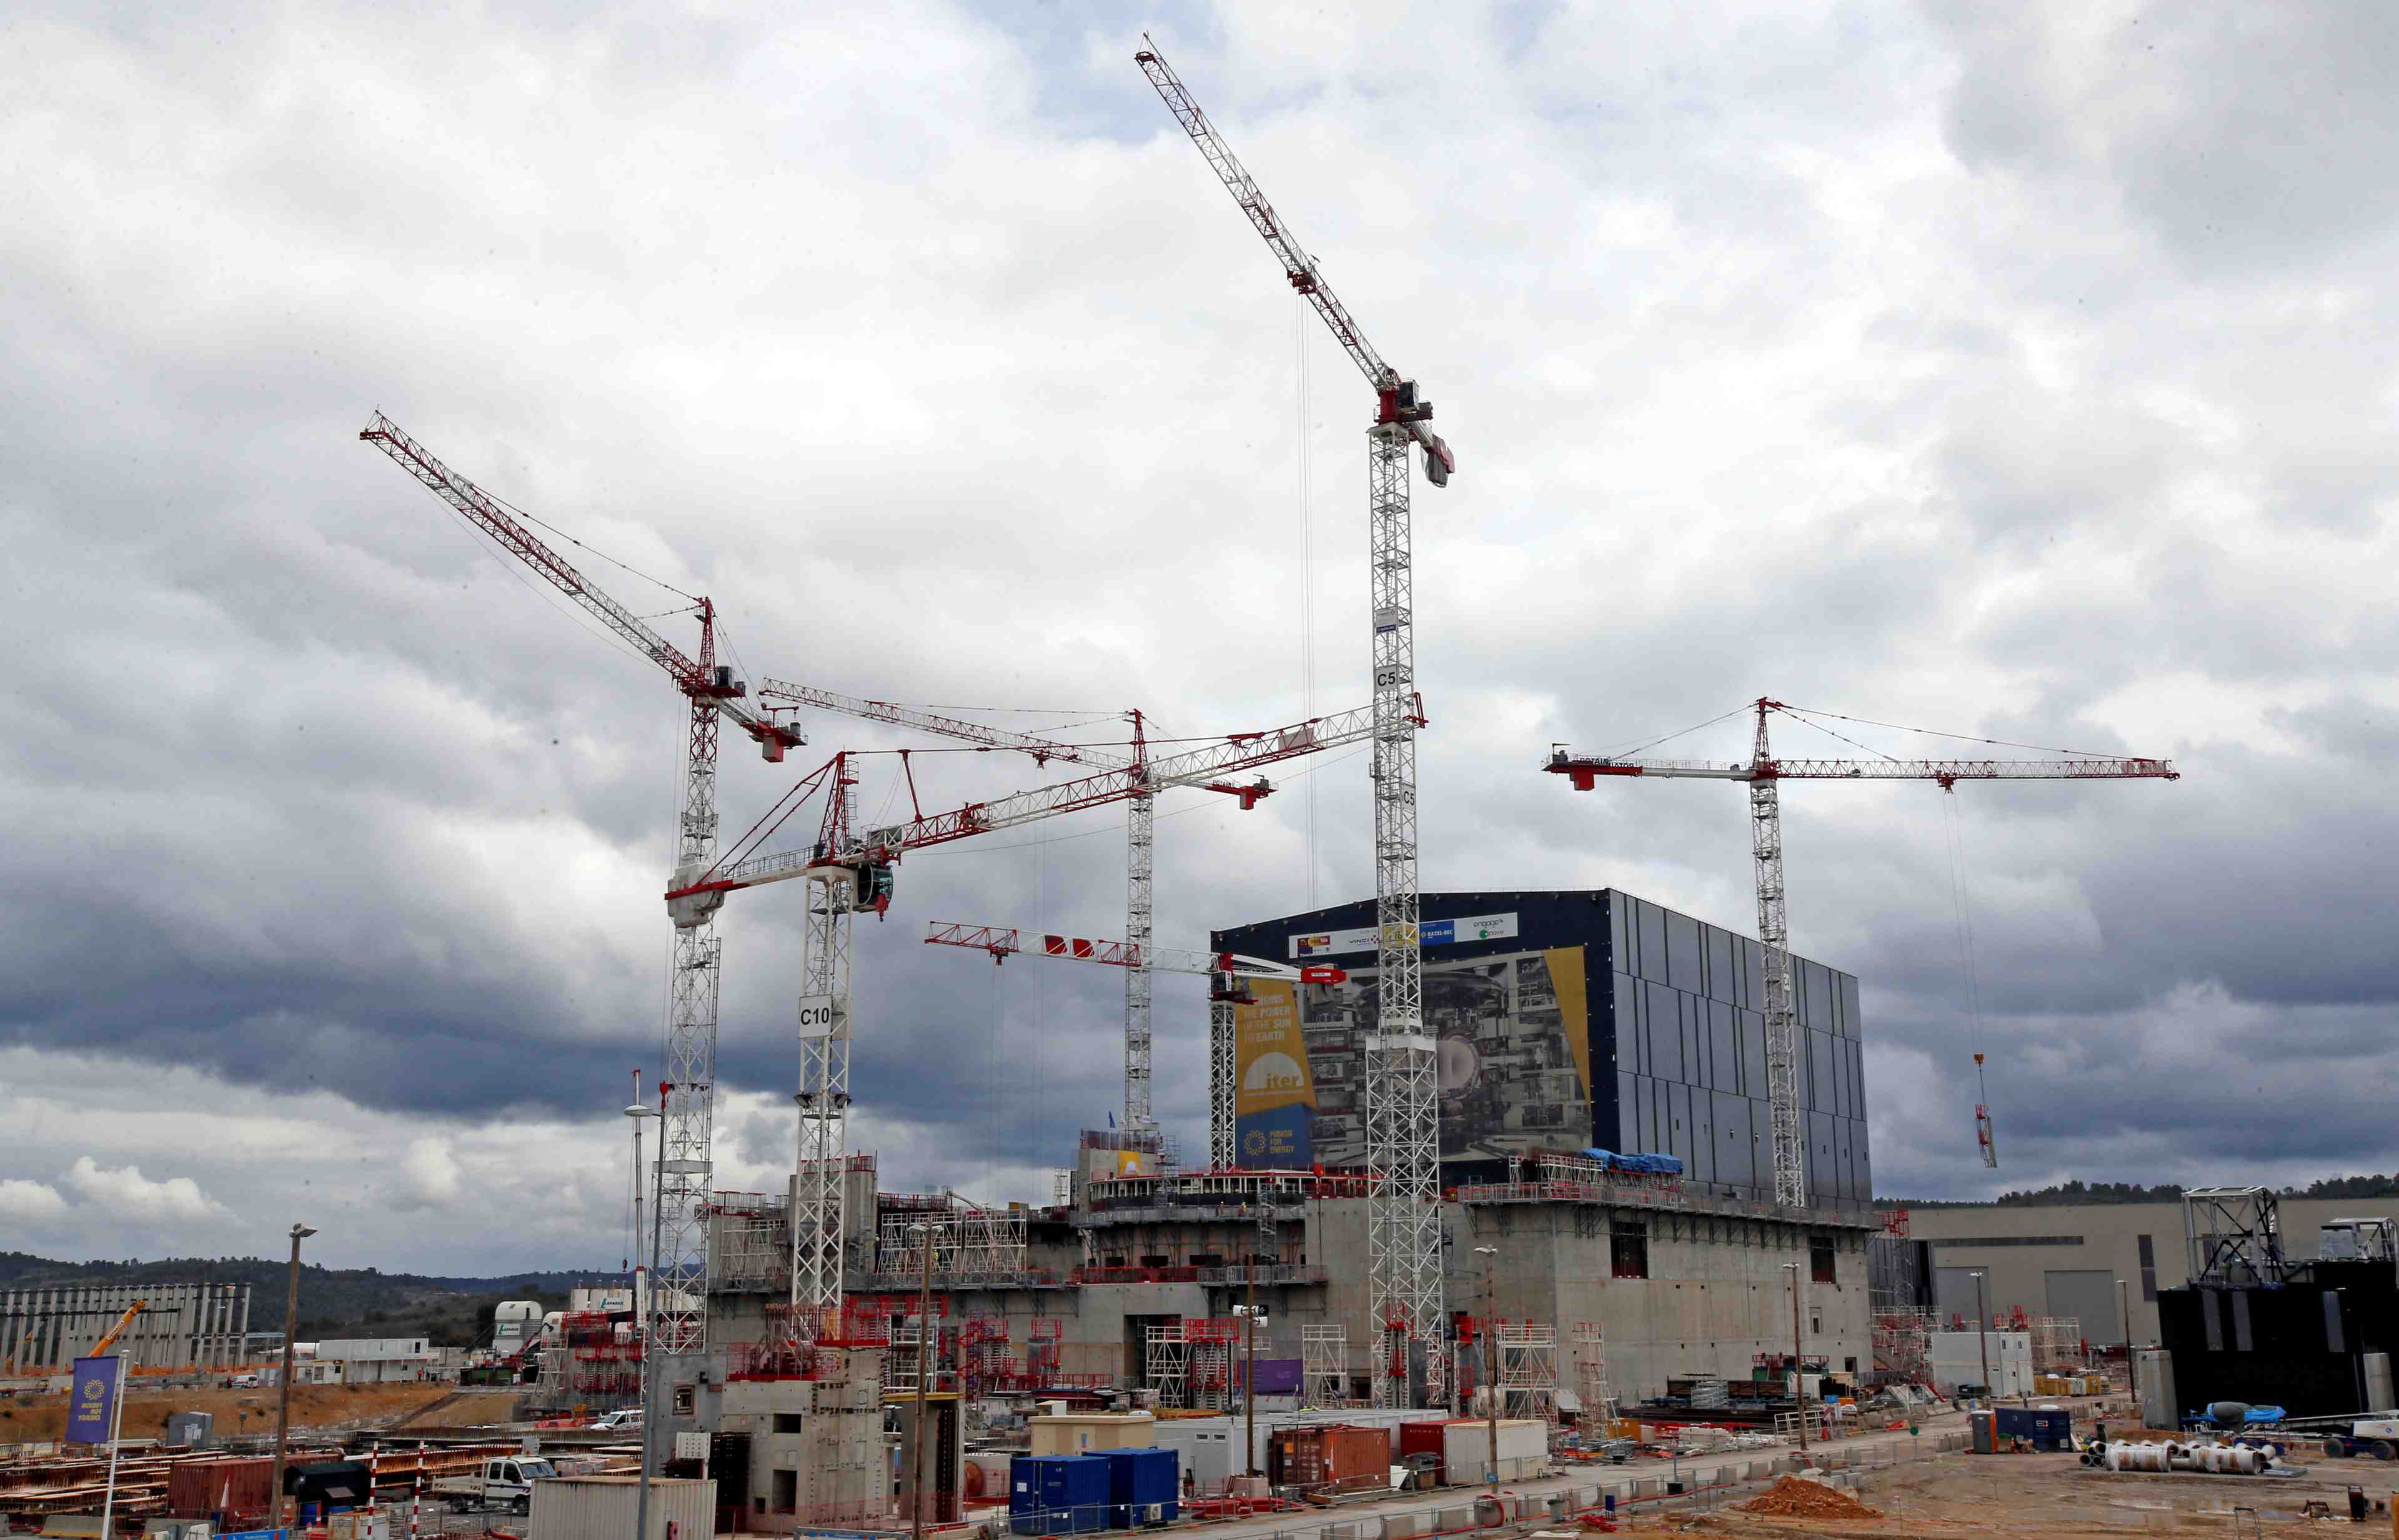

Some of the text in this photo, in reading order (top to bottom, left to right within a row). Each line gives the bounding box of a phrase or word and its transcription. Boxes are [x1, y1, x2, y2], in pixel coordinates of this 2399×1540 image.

[1378, 672, 1396, 687] C5
[800, 1007, 830, 1025] C10
[1266, 1073, 1299, 1089] iter
